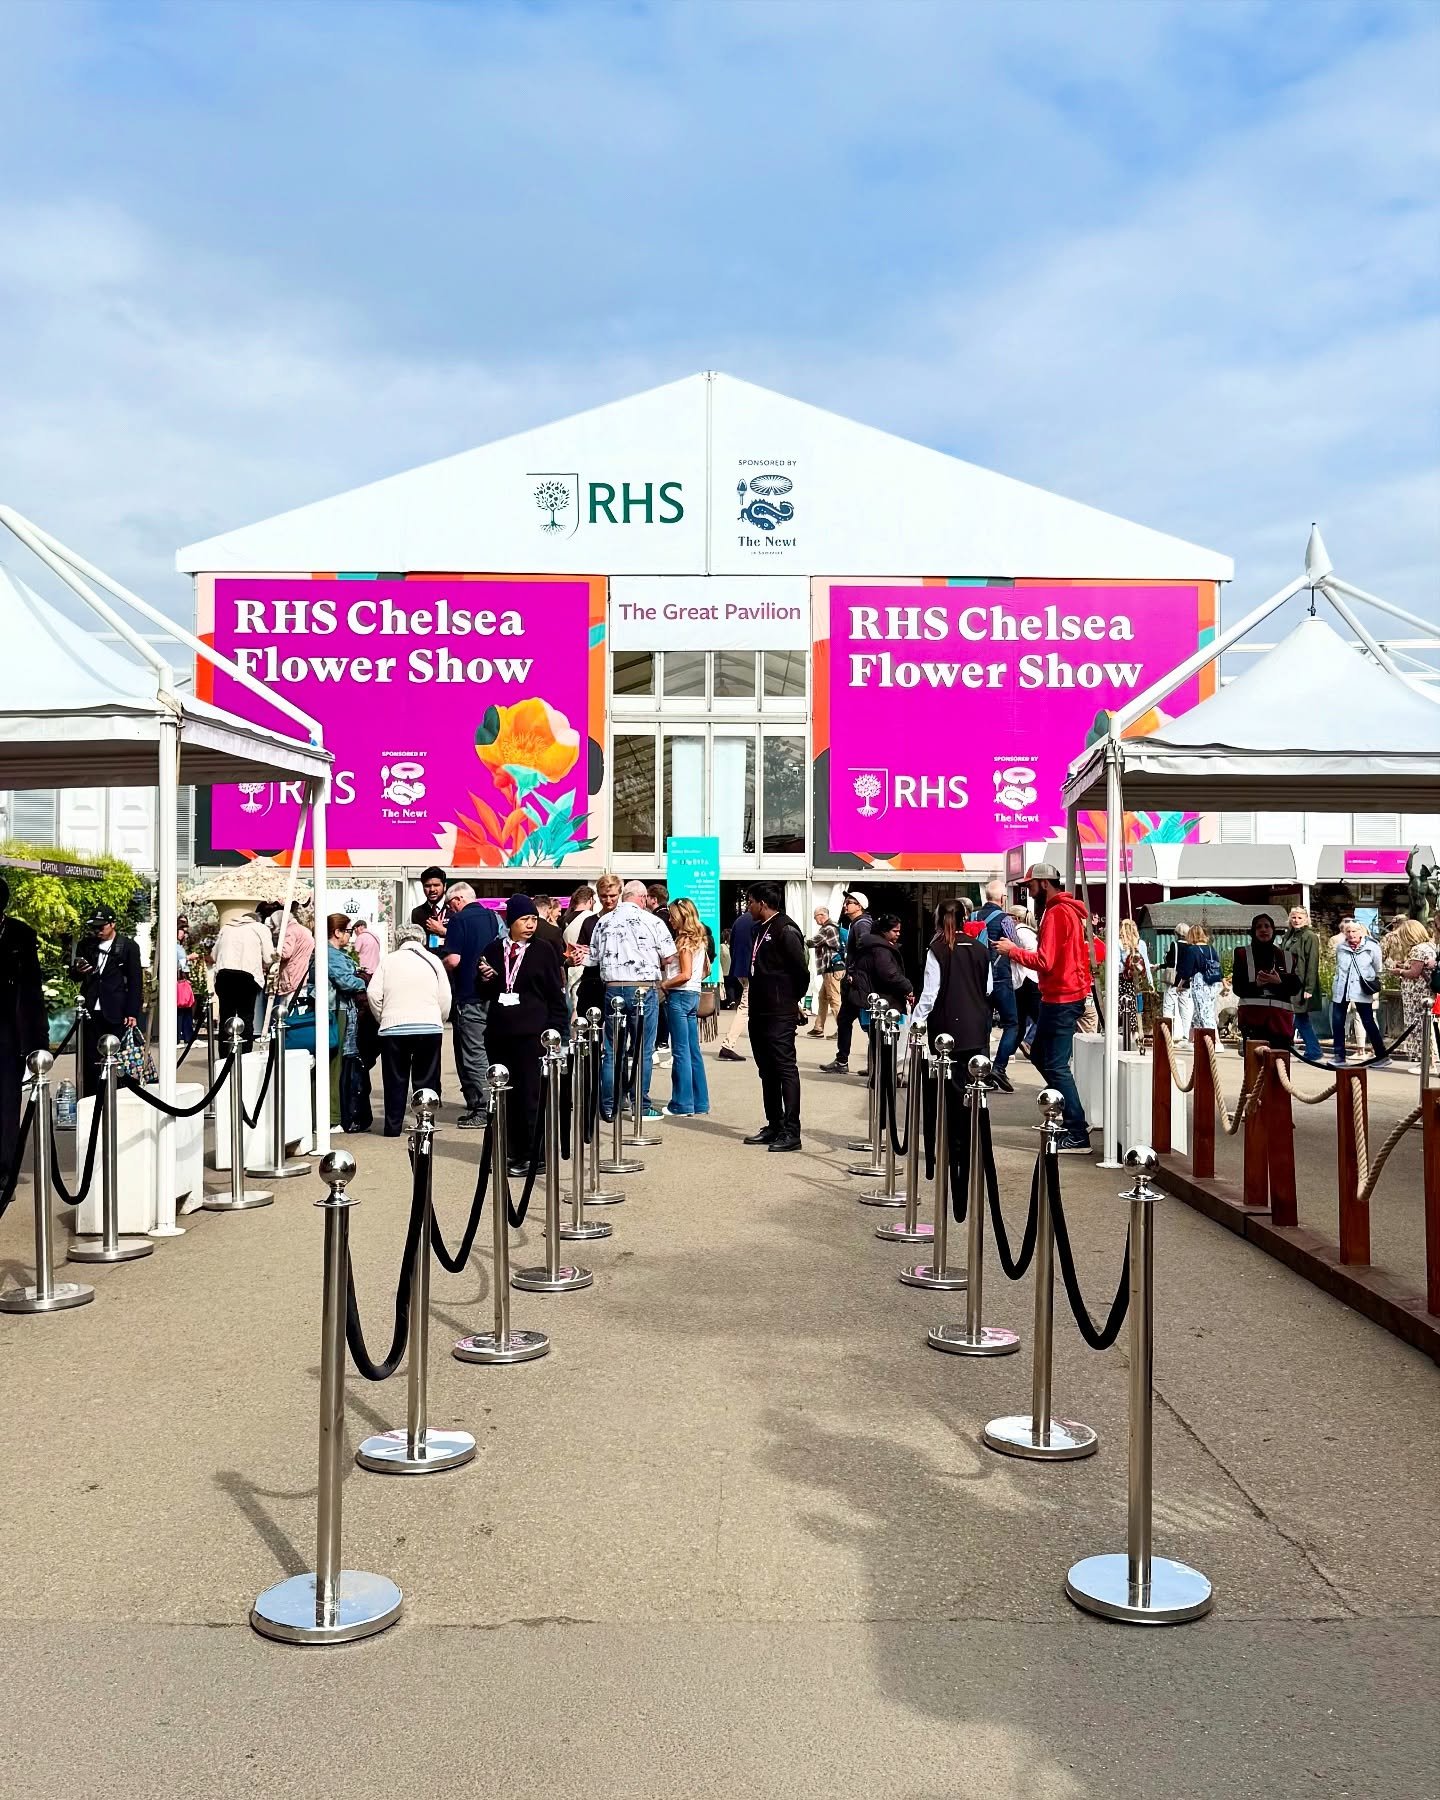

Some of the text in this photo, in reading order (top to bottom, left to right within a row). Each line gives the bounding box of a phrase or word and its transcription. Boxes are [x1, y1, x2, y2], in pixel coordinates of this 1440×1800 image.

[738, 459, 797, 467] SPONSORED BY
[588, 481, 685, 524] RHS
[737, 536, 797, 547] The Newt
[233, 598, 525, 636] RHS Chelsea
[618, 601, 801, 621] The Great Pavilion
[848, 605, 1135, 641] RHS Chelsea
[232, 646, 534, 684] Flower Show
[848, 651, 1144, 689] Flower Show
[894, 775, 969, 809] RHS
[381, 808, 428, 818] The Newt
[994, 813, 1040, 823] The Newt
[41, 862, 59, 873] CAPITAL
